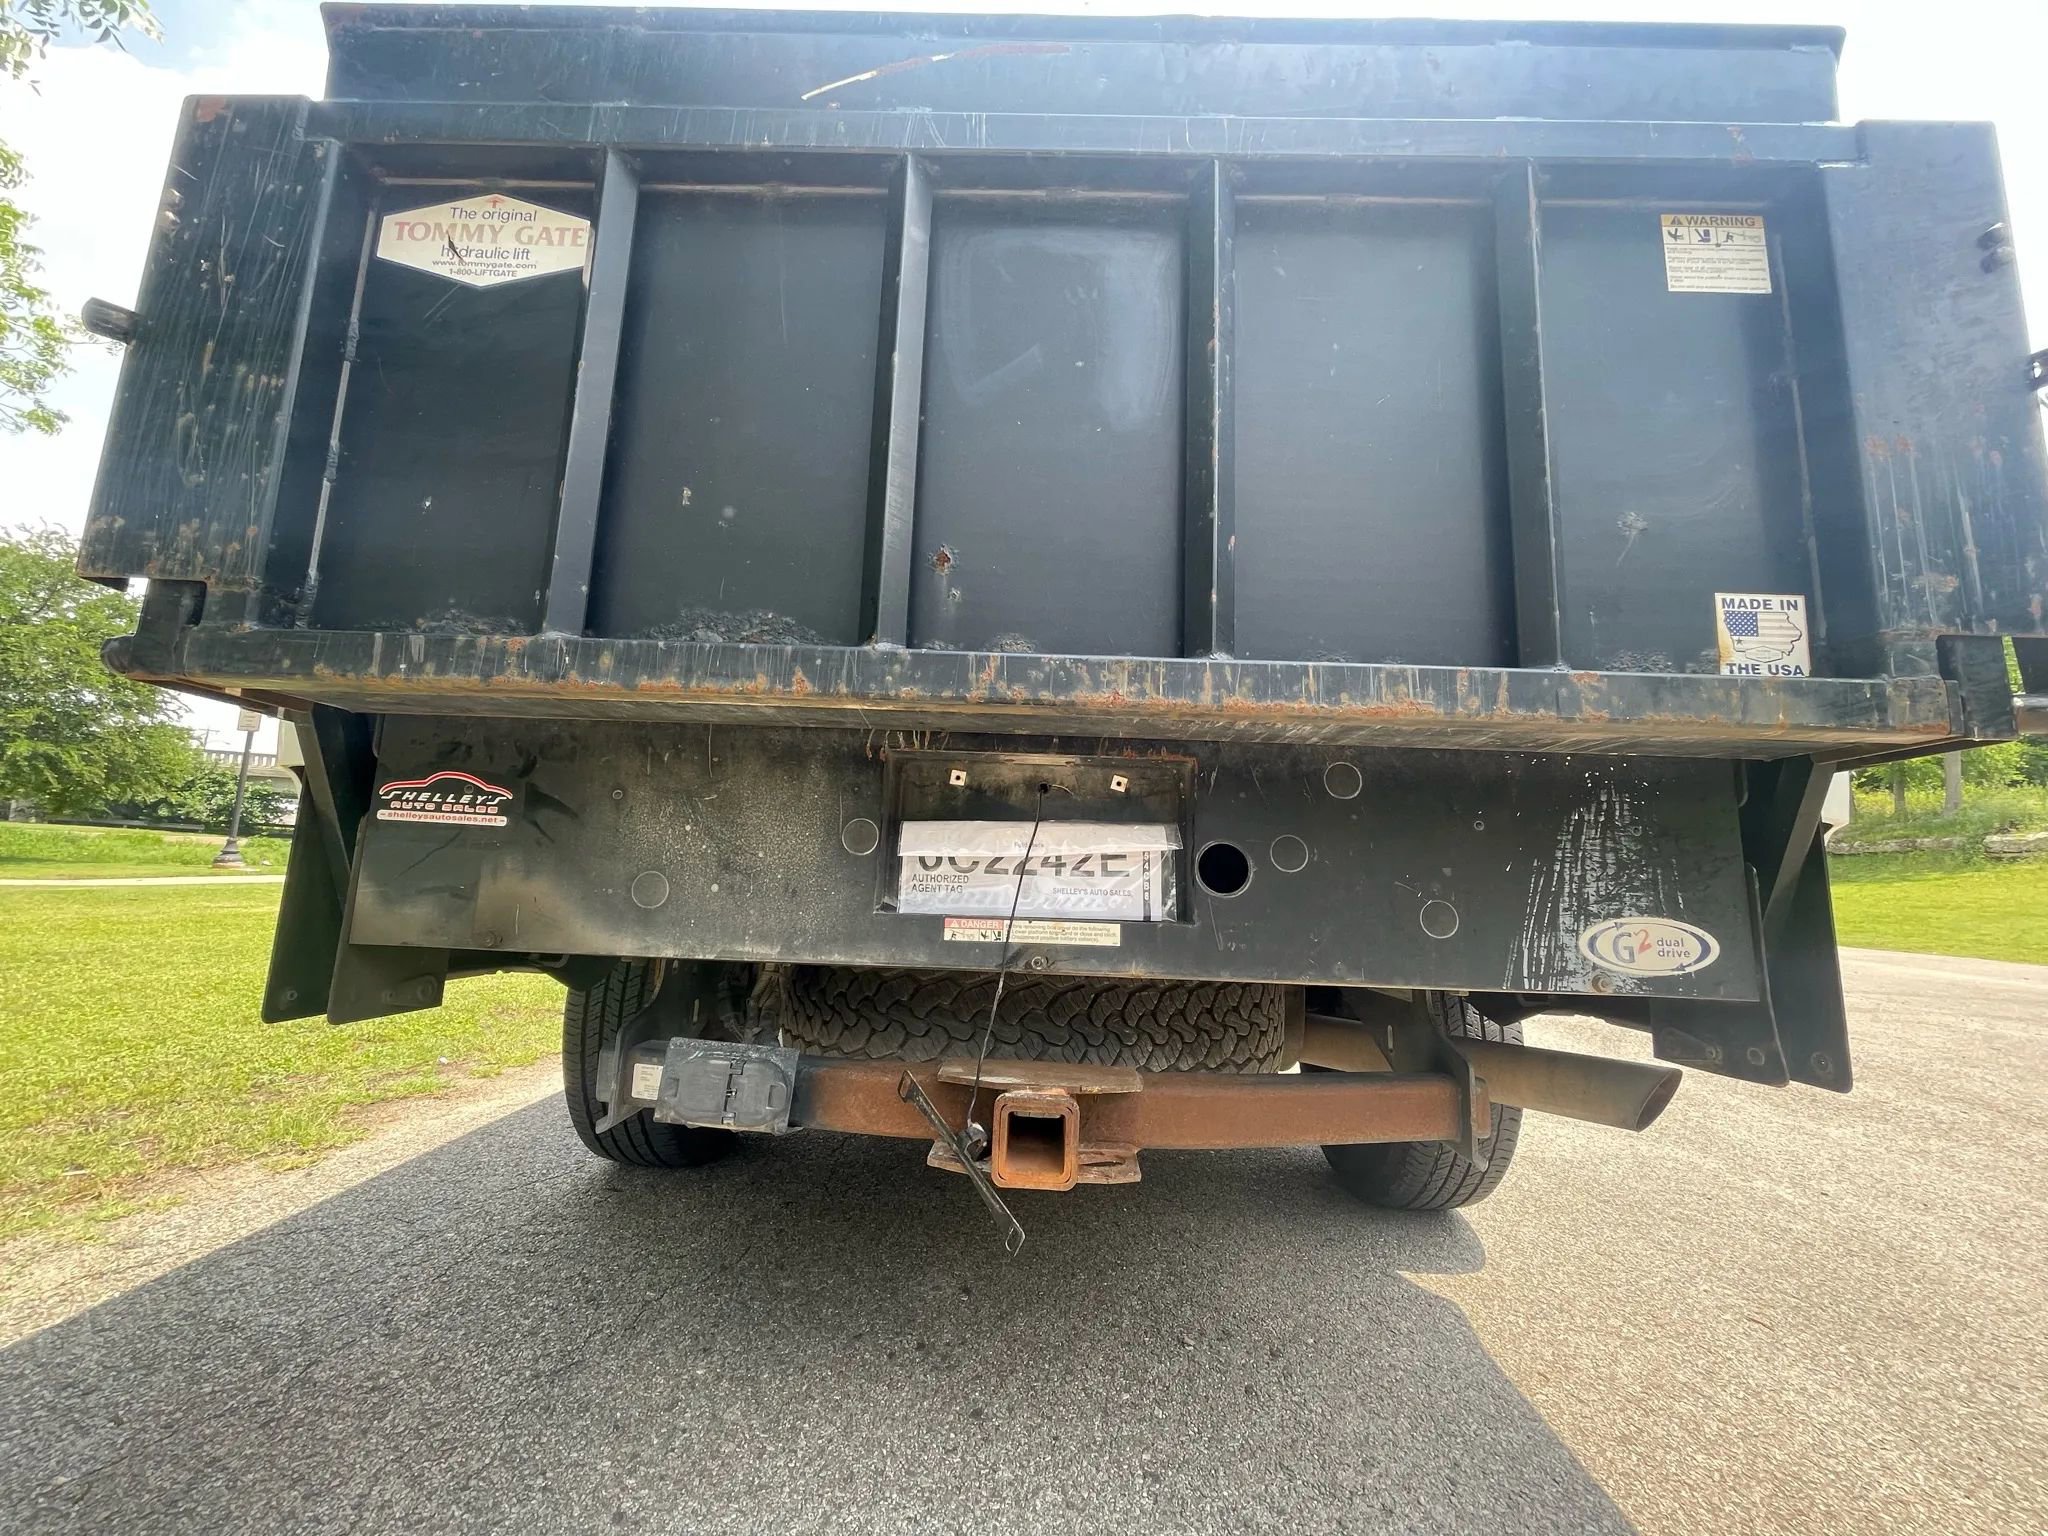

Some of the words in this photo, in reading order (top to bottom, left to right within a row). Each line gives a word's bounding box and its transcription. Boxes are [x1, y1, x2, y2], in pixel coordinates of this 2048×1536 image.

[450, 207, 477, 220] The
[482, 209, 537, 224] original
[1685, 216, 1755, 226] WARNING
[394, 221, 504, 244] TOMMY
[515, 226, 586, 247] GATE
[441, 244, 510, 261] hydraulic
[512, 248, 530, 261] lift
[432, 260, 537, 270] www.tommygate.com
[449, 268, 517, 278] 1-800-LIFTGATE
[1721, 598, 1773, 610] MADE
[1780, 599, 1798, 611] IN
[1726, 663, 1762, 675] THE
[1768, 664, 1805, 676] USA
[381, 791, 507, 805] SHELLEY'S
[390, 801, 436, 810] AUTO
[441, 804, 498, 814] SALES
[387, 811, 498, 824] shelleysautosales.net
[911, 874, 969, 884] AUTHORIZED
[911, 883, 941, 893] AGENT
[945, 884, 963, 894] TAG
[1052, 887, 1088, 895] SHELLEY'S
[1089, 888, 1108, 896] AUTO
[960, 919, 999, 929] DANGER
[1656, 937, 1684, 947] dual
[1657, 949, 1691, 958] drive
